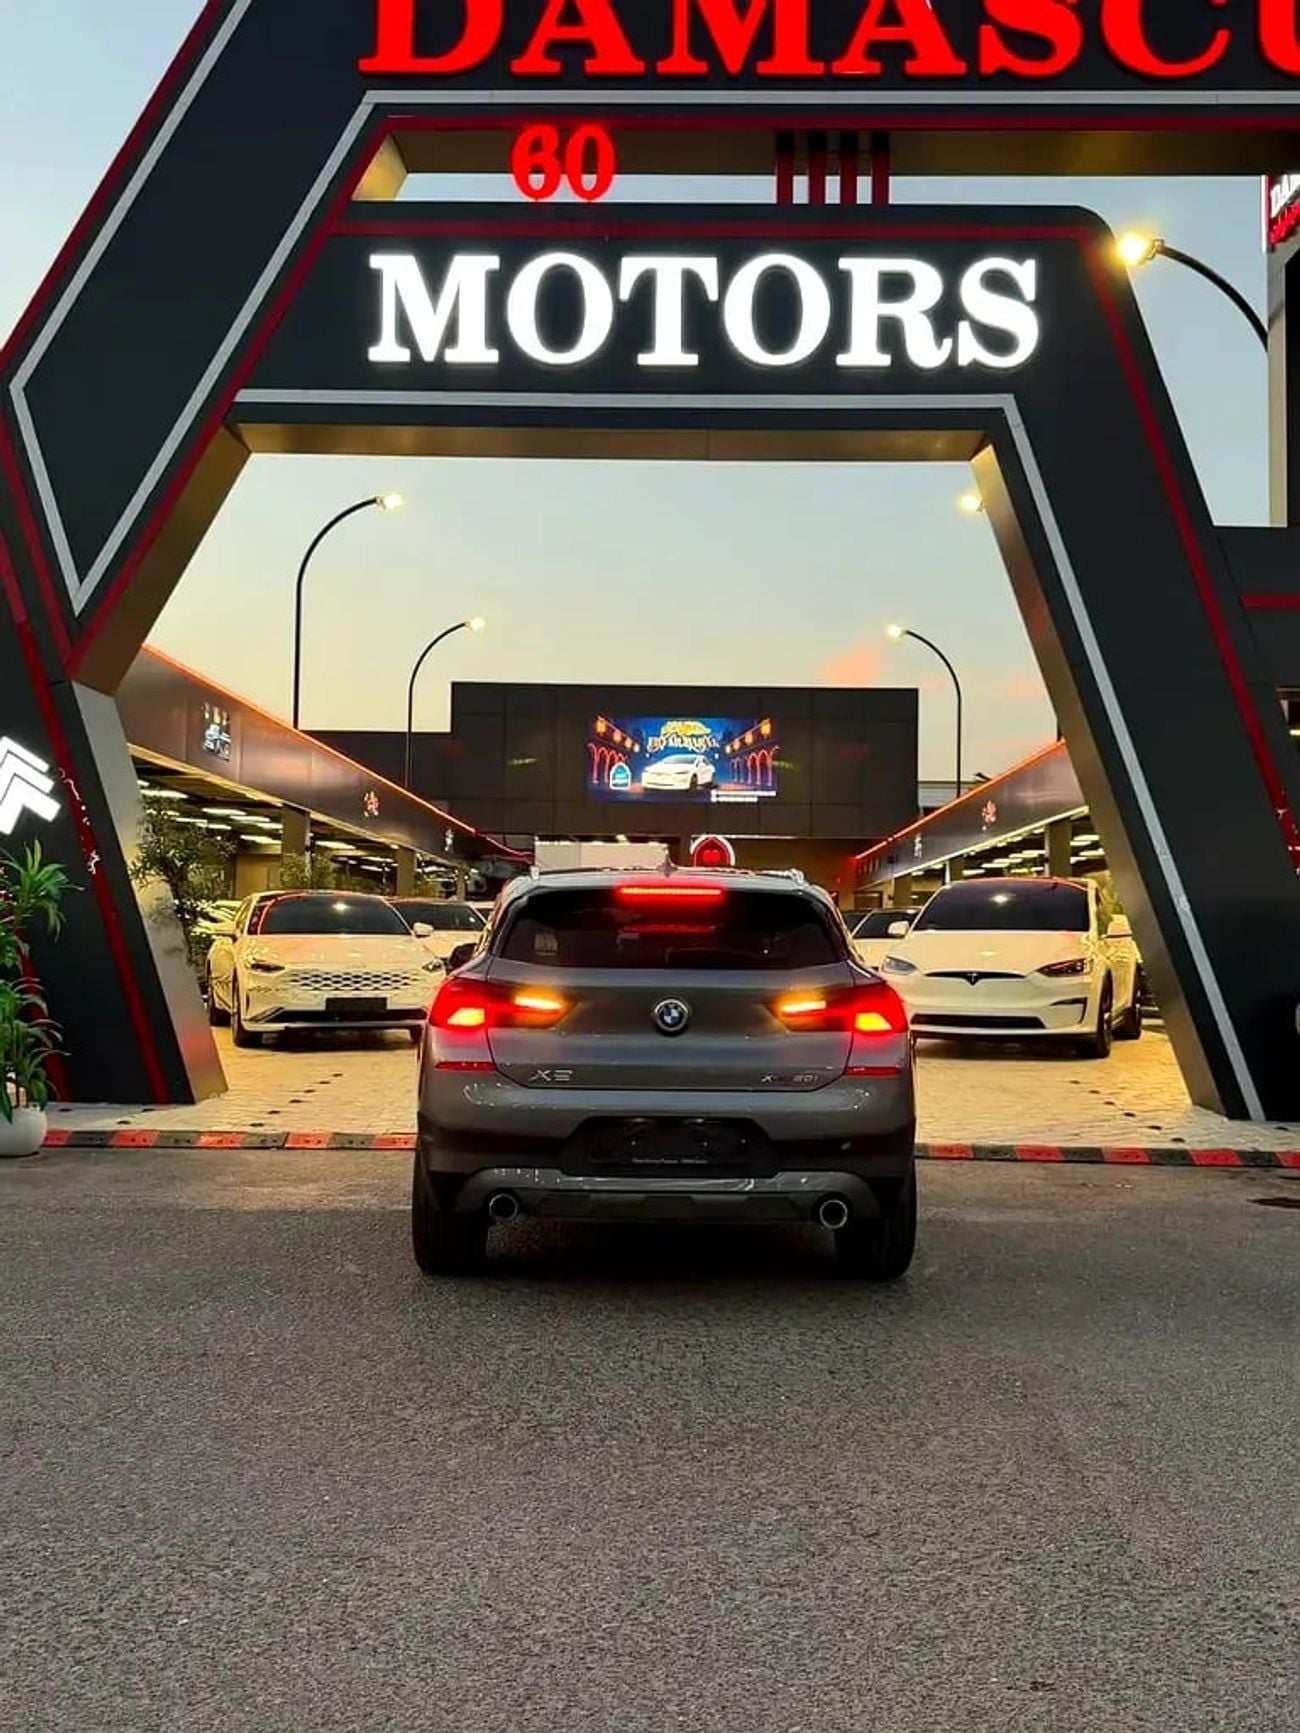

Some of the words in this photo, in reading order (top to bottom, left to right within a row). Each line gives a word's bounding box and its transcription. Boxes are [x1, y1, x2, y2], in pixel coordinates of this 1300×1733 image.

[358, 0, 1300, 77] DAMASC
[510, 123, 616, 202] 60
[366, 250, 1041, 370] MOTORS
